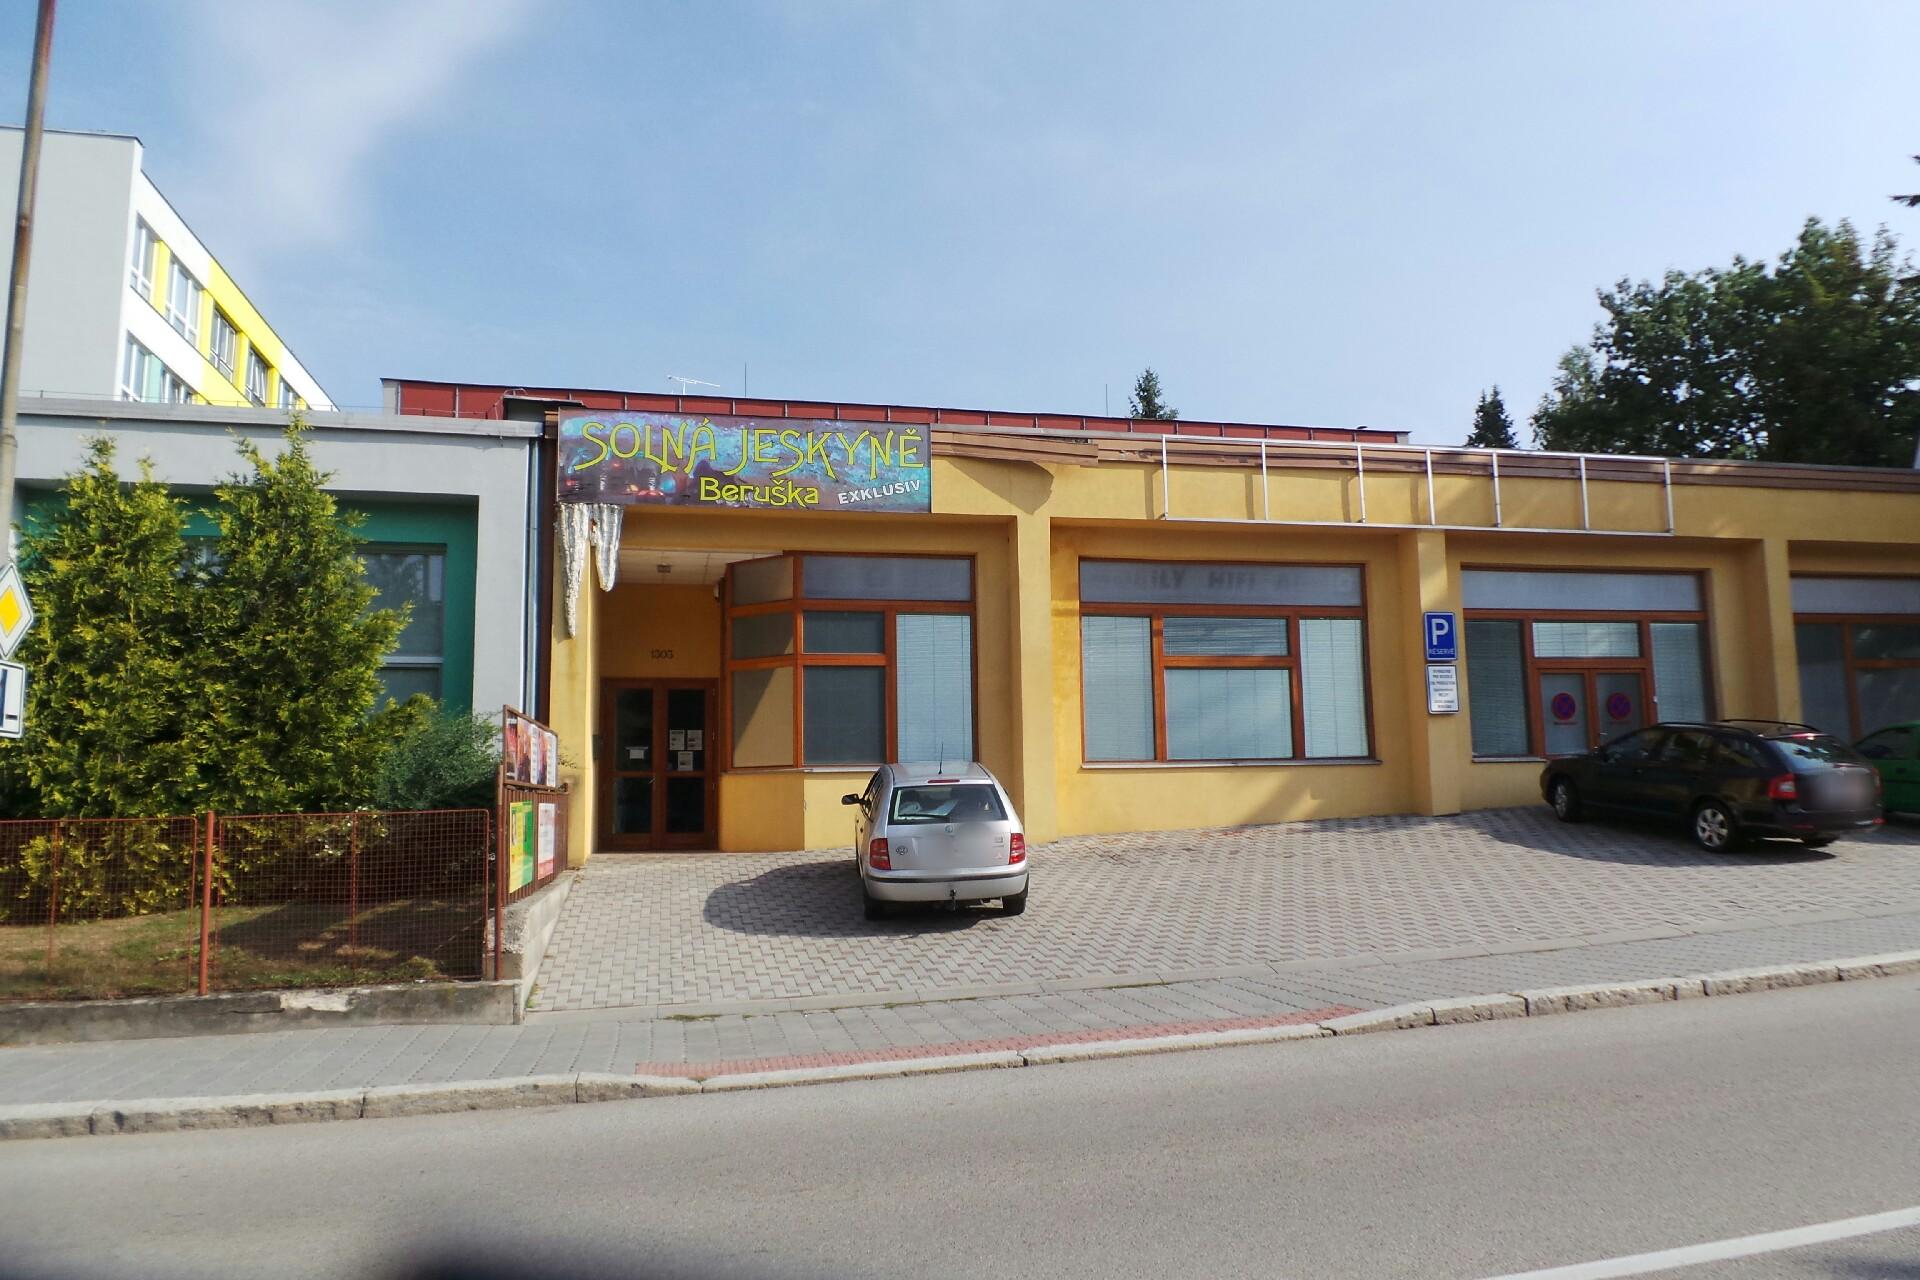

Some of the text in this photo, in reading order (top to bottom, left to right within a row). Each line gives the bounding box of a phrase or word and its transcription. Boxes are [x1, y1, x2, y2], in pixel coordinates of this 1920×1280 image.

[574, 417, 925, 482] SOLNÁ JESKYNĚ
[699, 476, 820, 510] Beruška
[837, 479, 922, 506] EXKLUSIV
[1431, 617, 1449, 646] P
